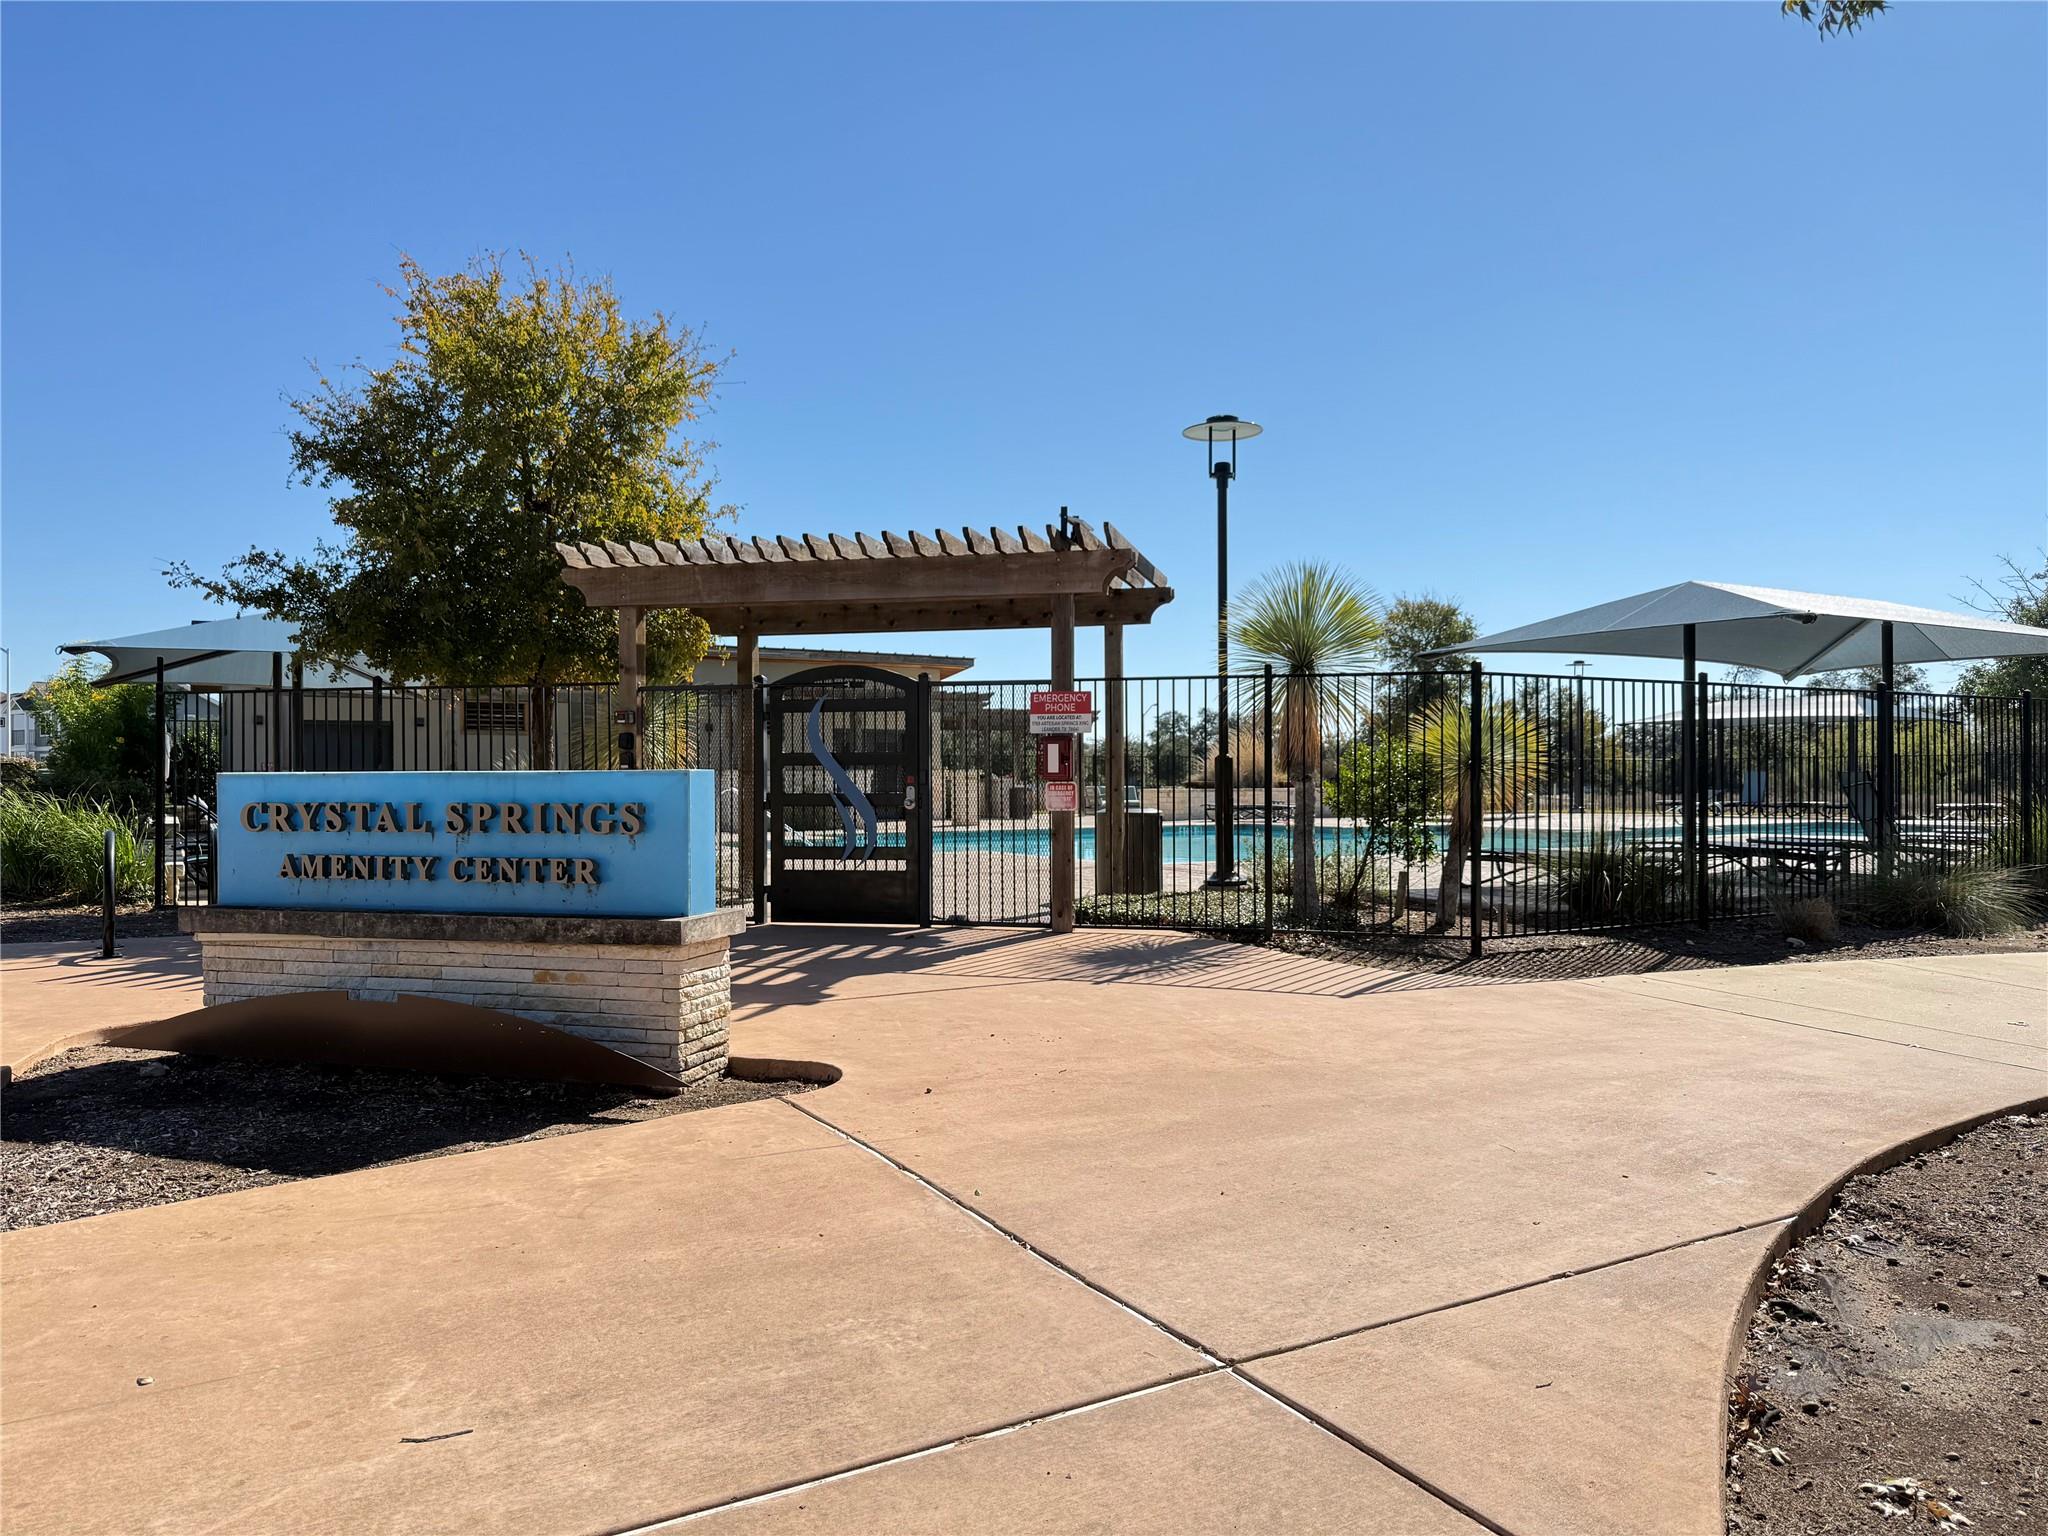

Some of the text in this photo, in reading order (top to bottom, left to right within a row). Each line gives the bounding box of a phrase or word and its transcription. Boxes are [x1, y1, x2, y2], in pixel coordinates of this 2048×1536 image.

[1033, 693, 1087, 702] EMERGENCY
[1045, 703, 1076, 711] PHONE
[239, 802, 646, 835] CRYSTAL SPRINGS
[279, 853, 598, 884] AMENITY CENTER
